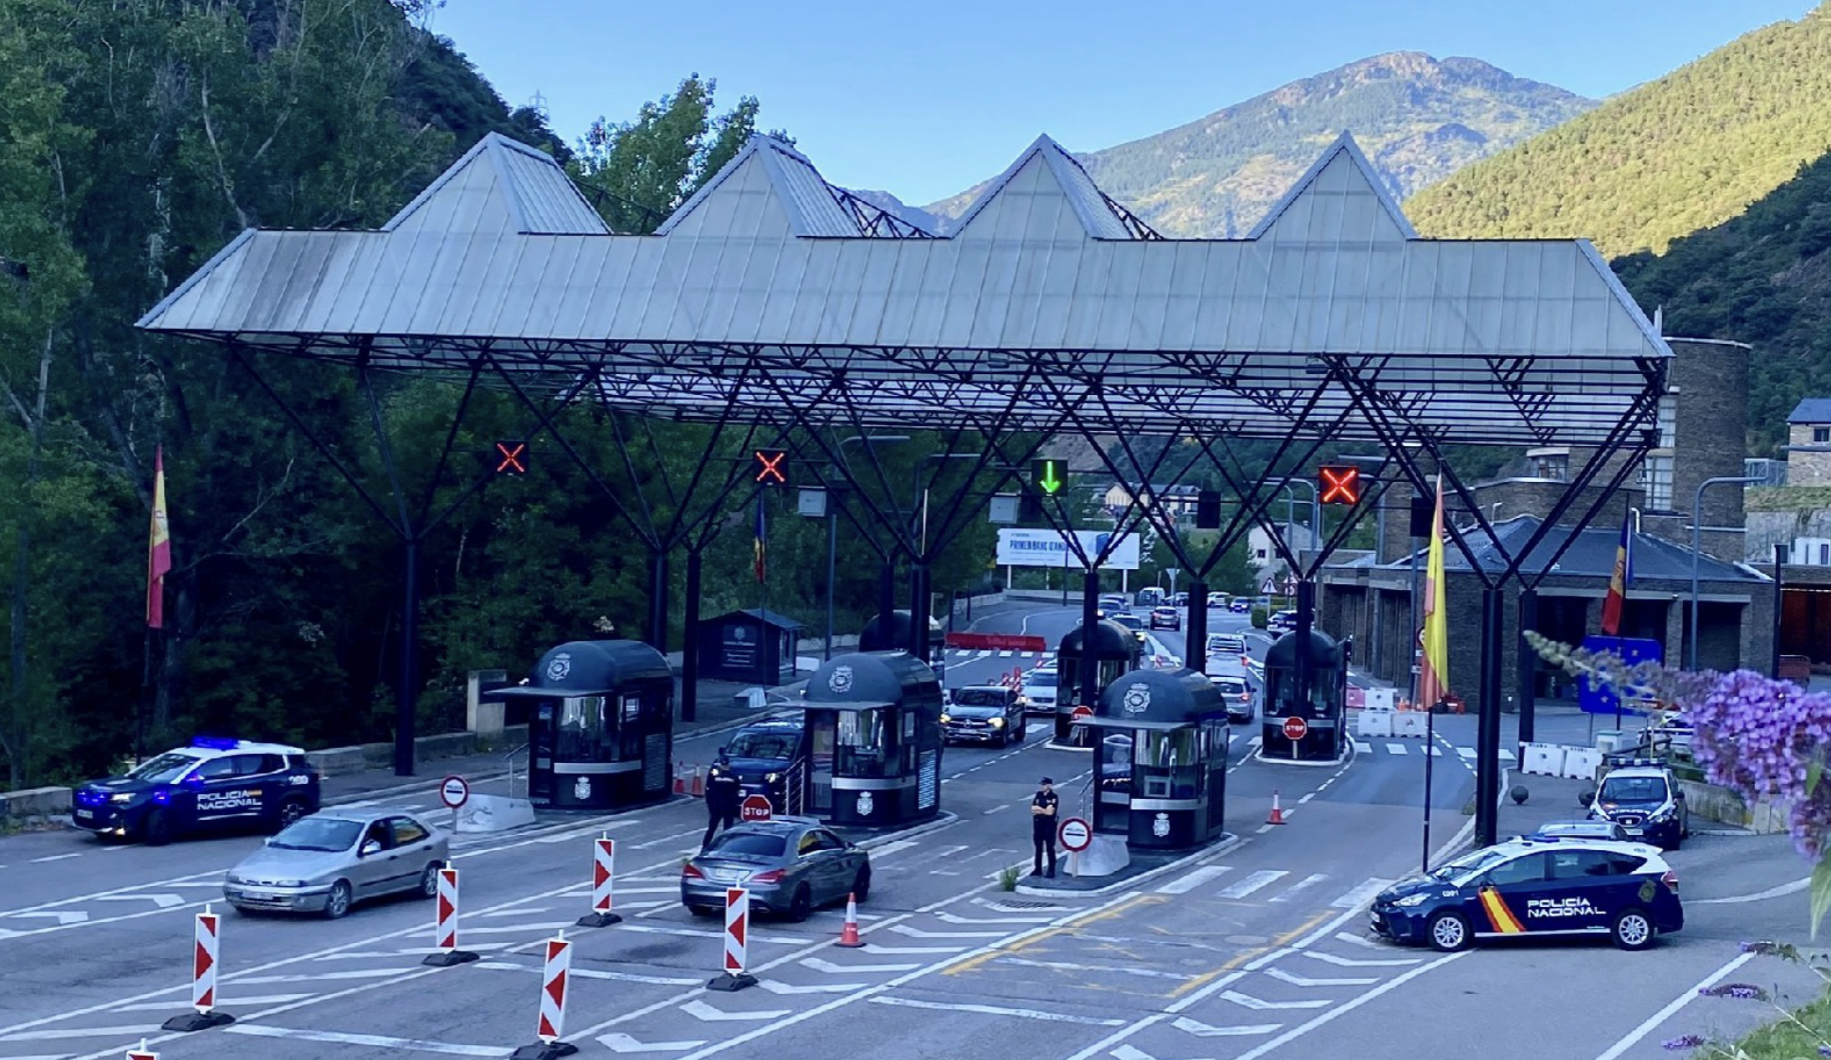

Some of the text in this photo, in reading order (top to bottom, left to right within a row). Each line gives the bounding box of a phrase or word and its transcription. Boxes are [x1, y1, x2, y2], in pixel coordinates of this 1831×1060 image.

[197, 798, 262, 810] NACIONAL
[744, 807, 769, 816] STOP
[1527, 896, 1590, 908] POLICÍA
[1528, 907, 1607, 918] NACIONAL
